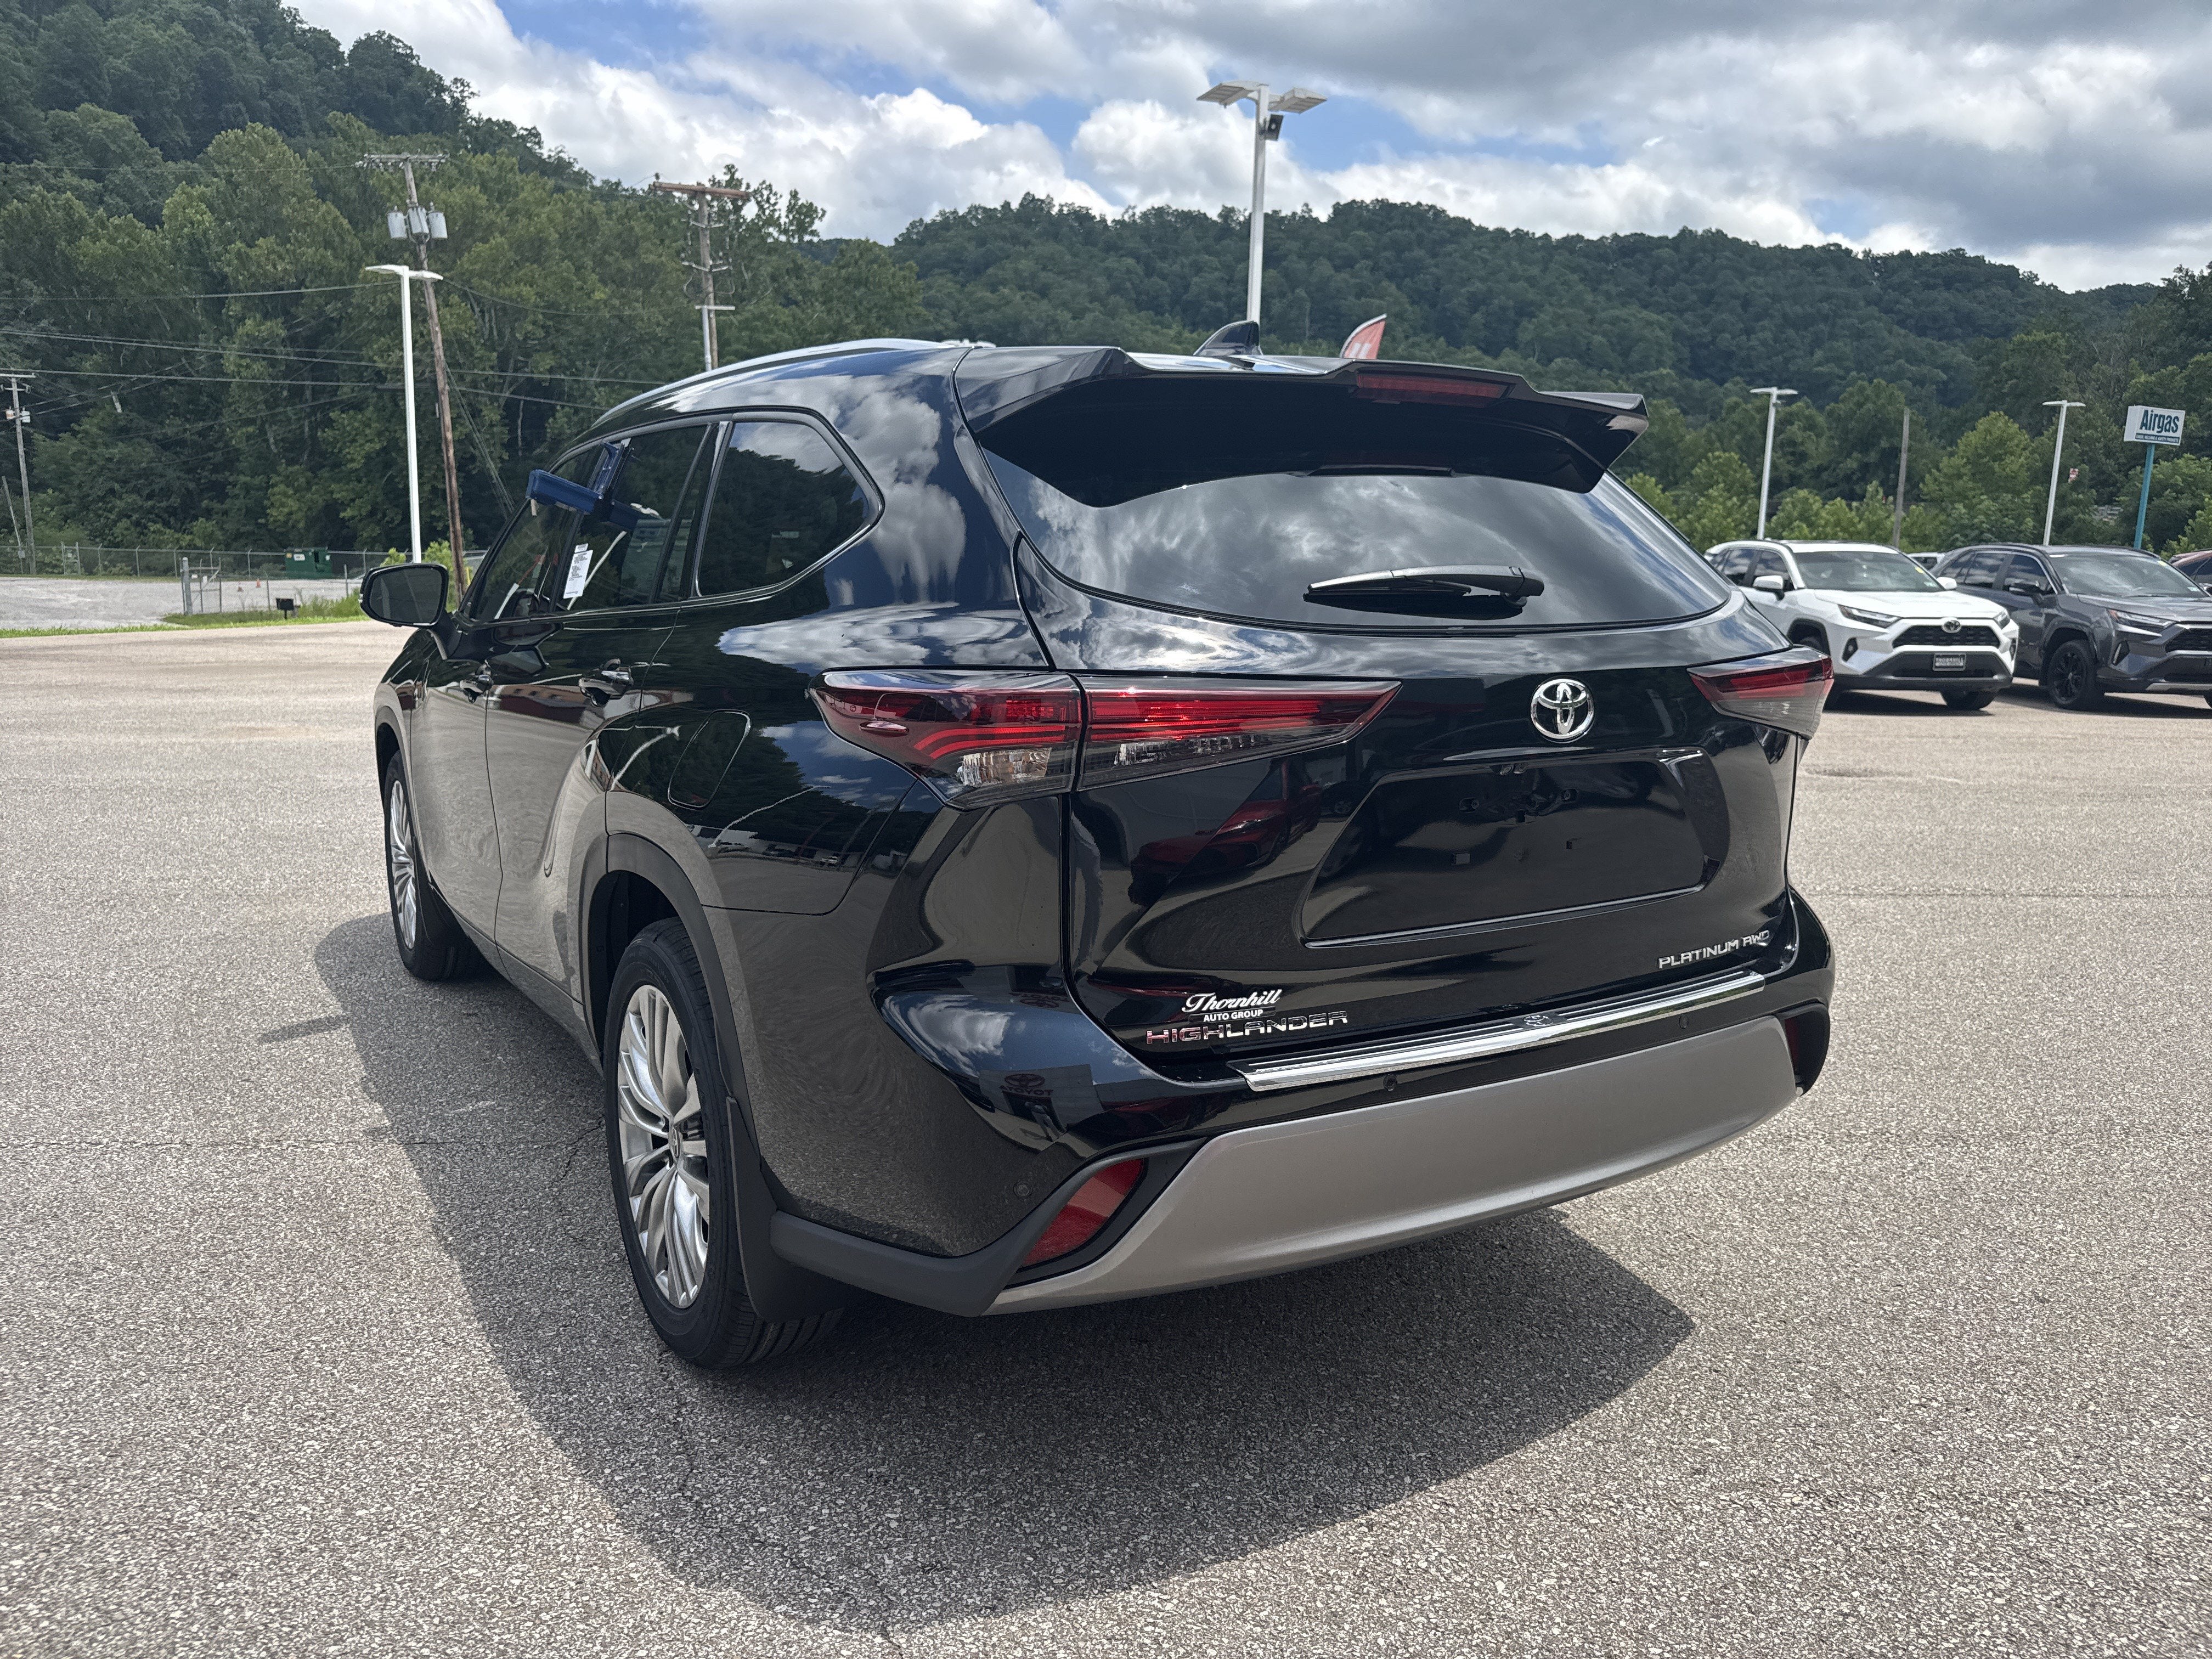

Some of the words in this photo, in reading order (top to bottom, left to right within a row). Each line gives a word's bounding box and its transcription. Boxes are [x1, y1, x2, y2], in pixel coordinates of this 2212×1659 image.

[2140, 409, 2179, 433] Airgas
[1658, 939, 1739, 969] PLATINUM
[1740, 929, 1770, 947] AWD
[1181, 989, 1282, 1013] Thornhill
[1147, 1011, 1348, 1044] HIGHLANDER
[1203, 1012, 1229, 1022] AUTO
[1231, 1009, 1263, 1019] GROUP
